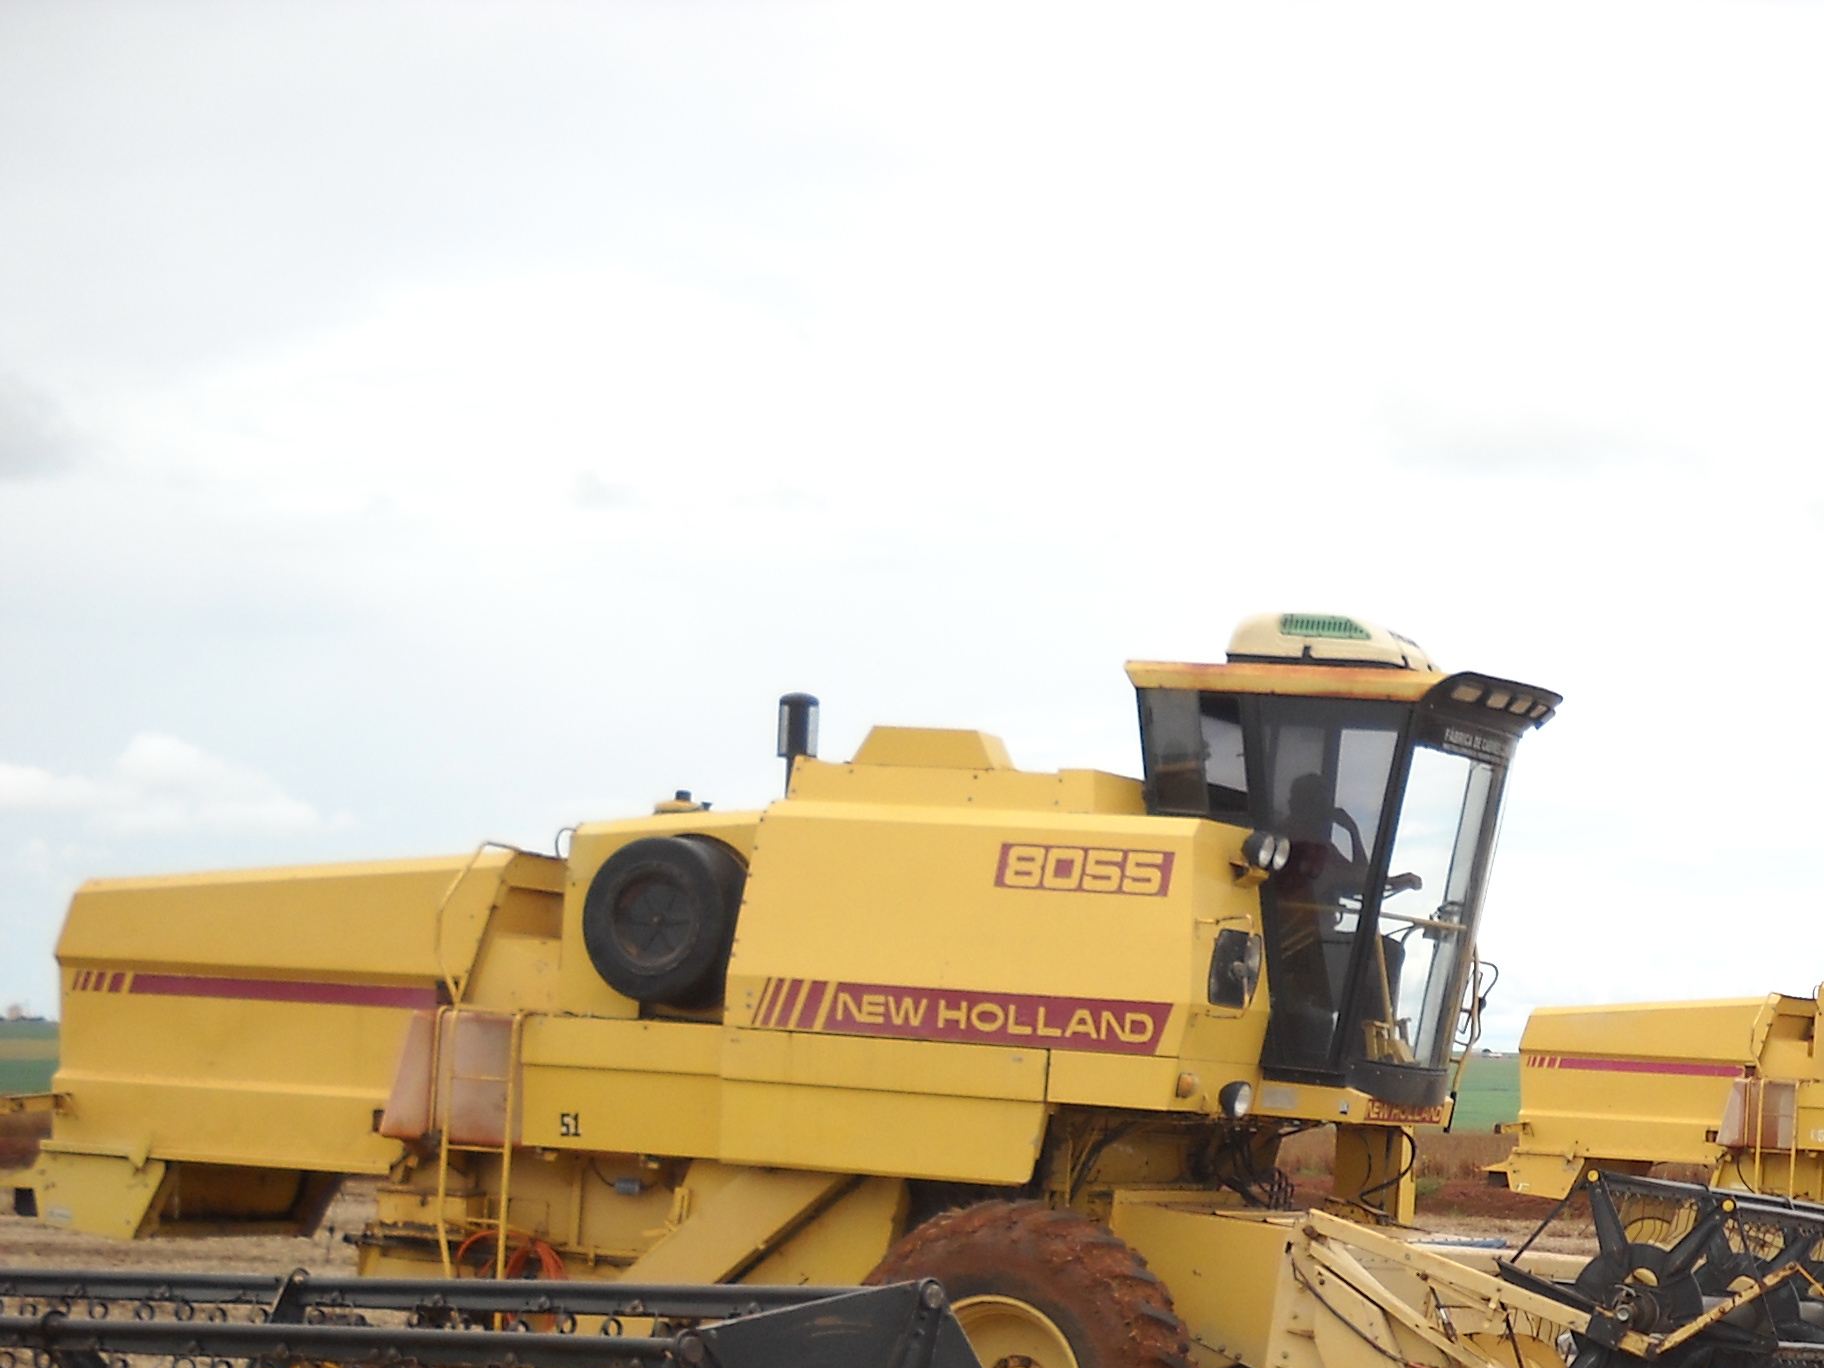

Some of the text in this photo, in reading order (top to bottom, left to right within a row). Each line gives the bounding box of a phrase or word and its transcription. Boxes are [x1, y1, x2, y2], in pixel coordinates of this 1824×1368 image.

[1003, 845, 1164, 894] 8055
[836, 992, 1155, 1044] NEW HOLLAND
[560, 1113, 581, 1137] 51
